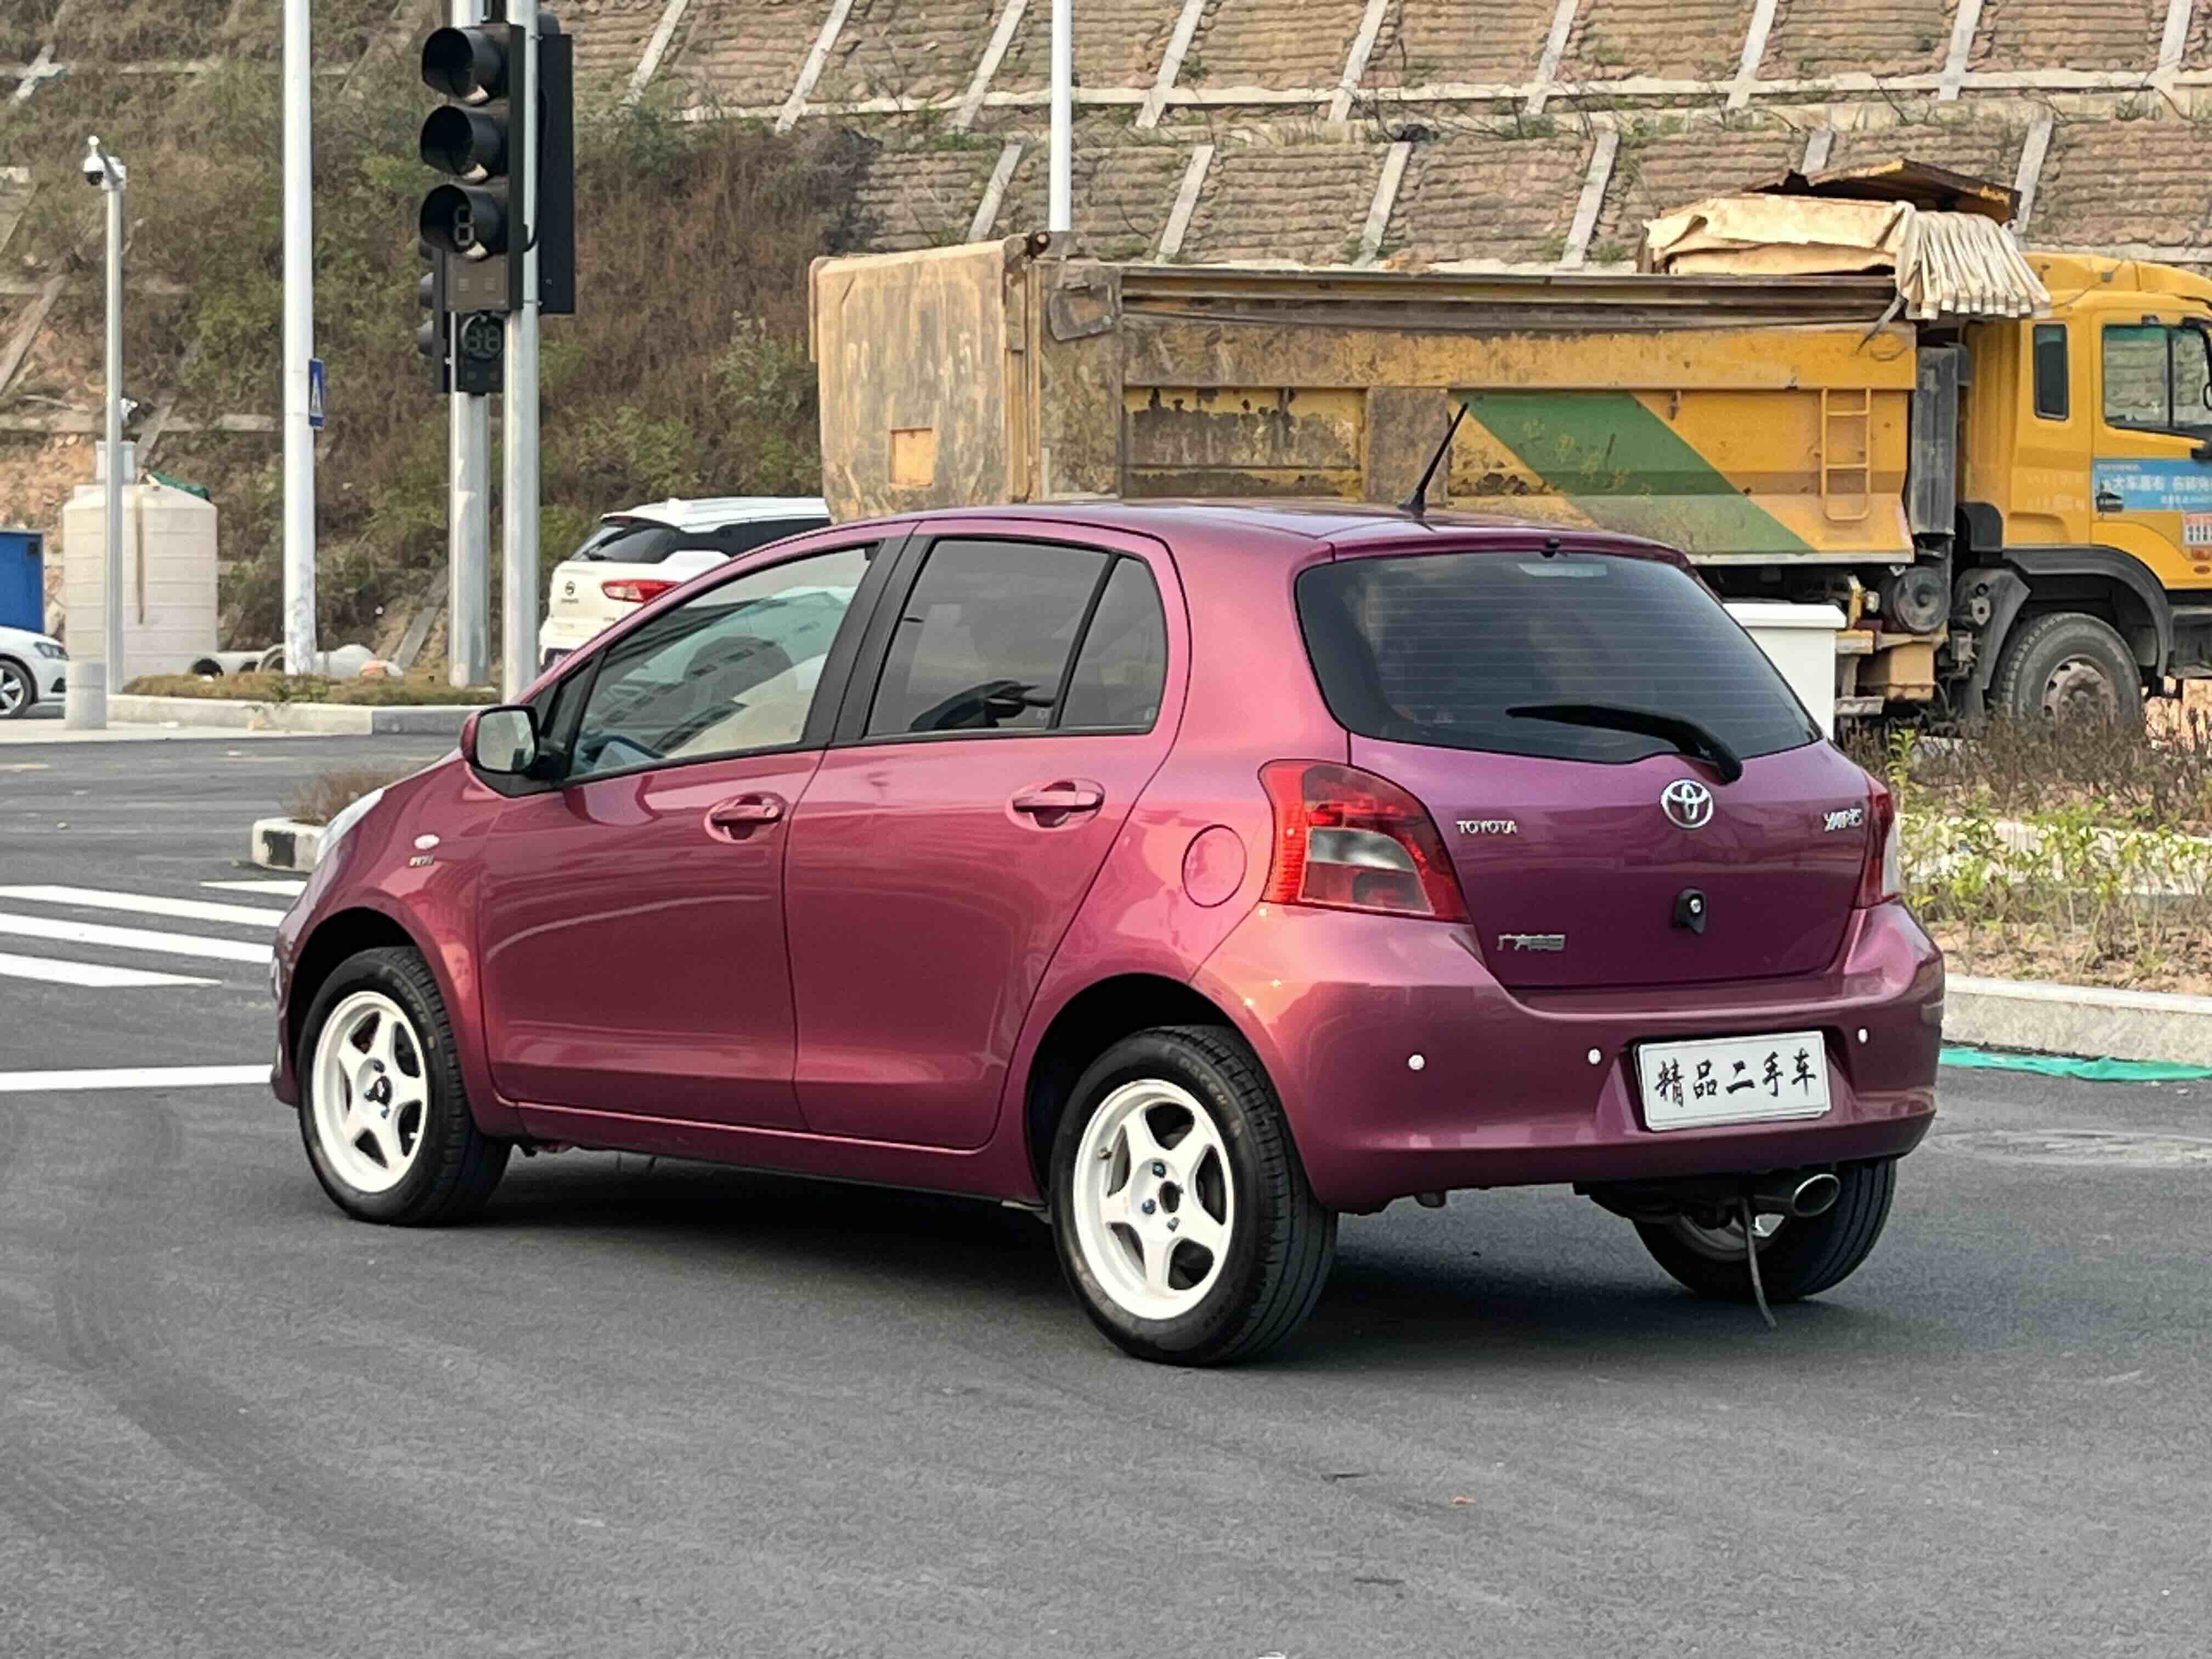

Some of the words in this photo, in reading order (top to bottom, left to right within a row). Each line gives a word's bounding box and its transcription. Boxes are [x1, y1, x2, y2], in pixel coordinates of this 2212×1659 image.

[1457, 820, 1517, 834] TOYOTA
[1655, 1048, 1816, 1107] 精品二手车
